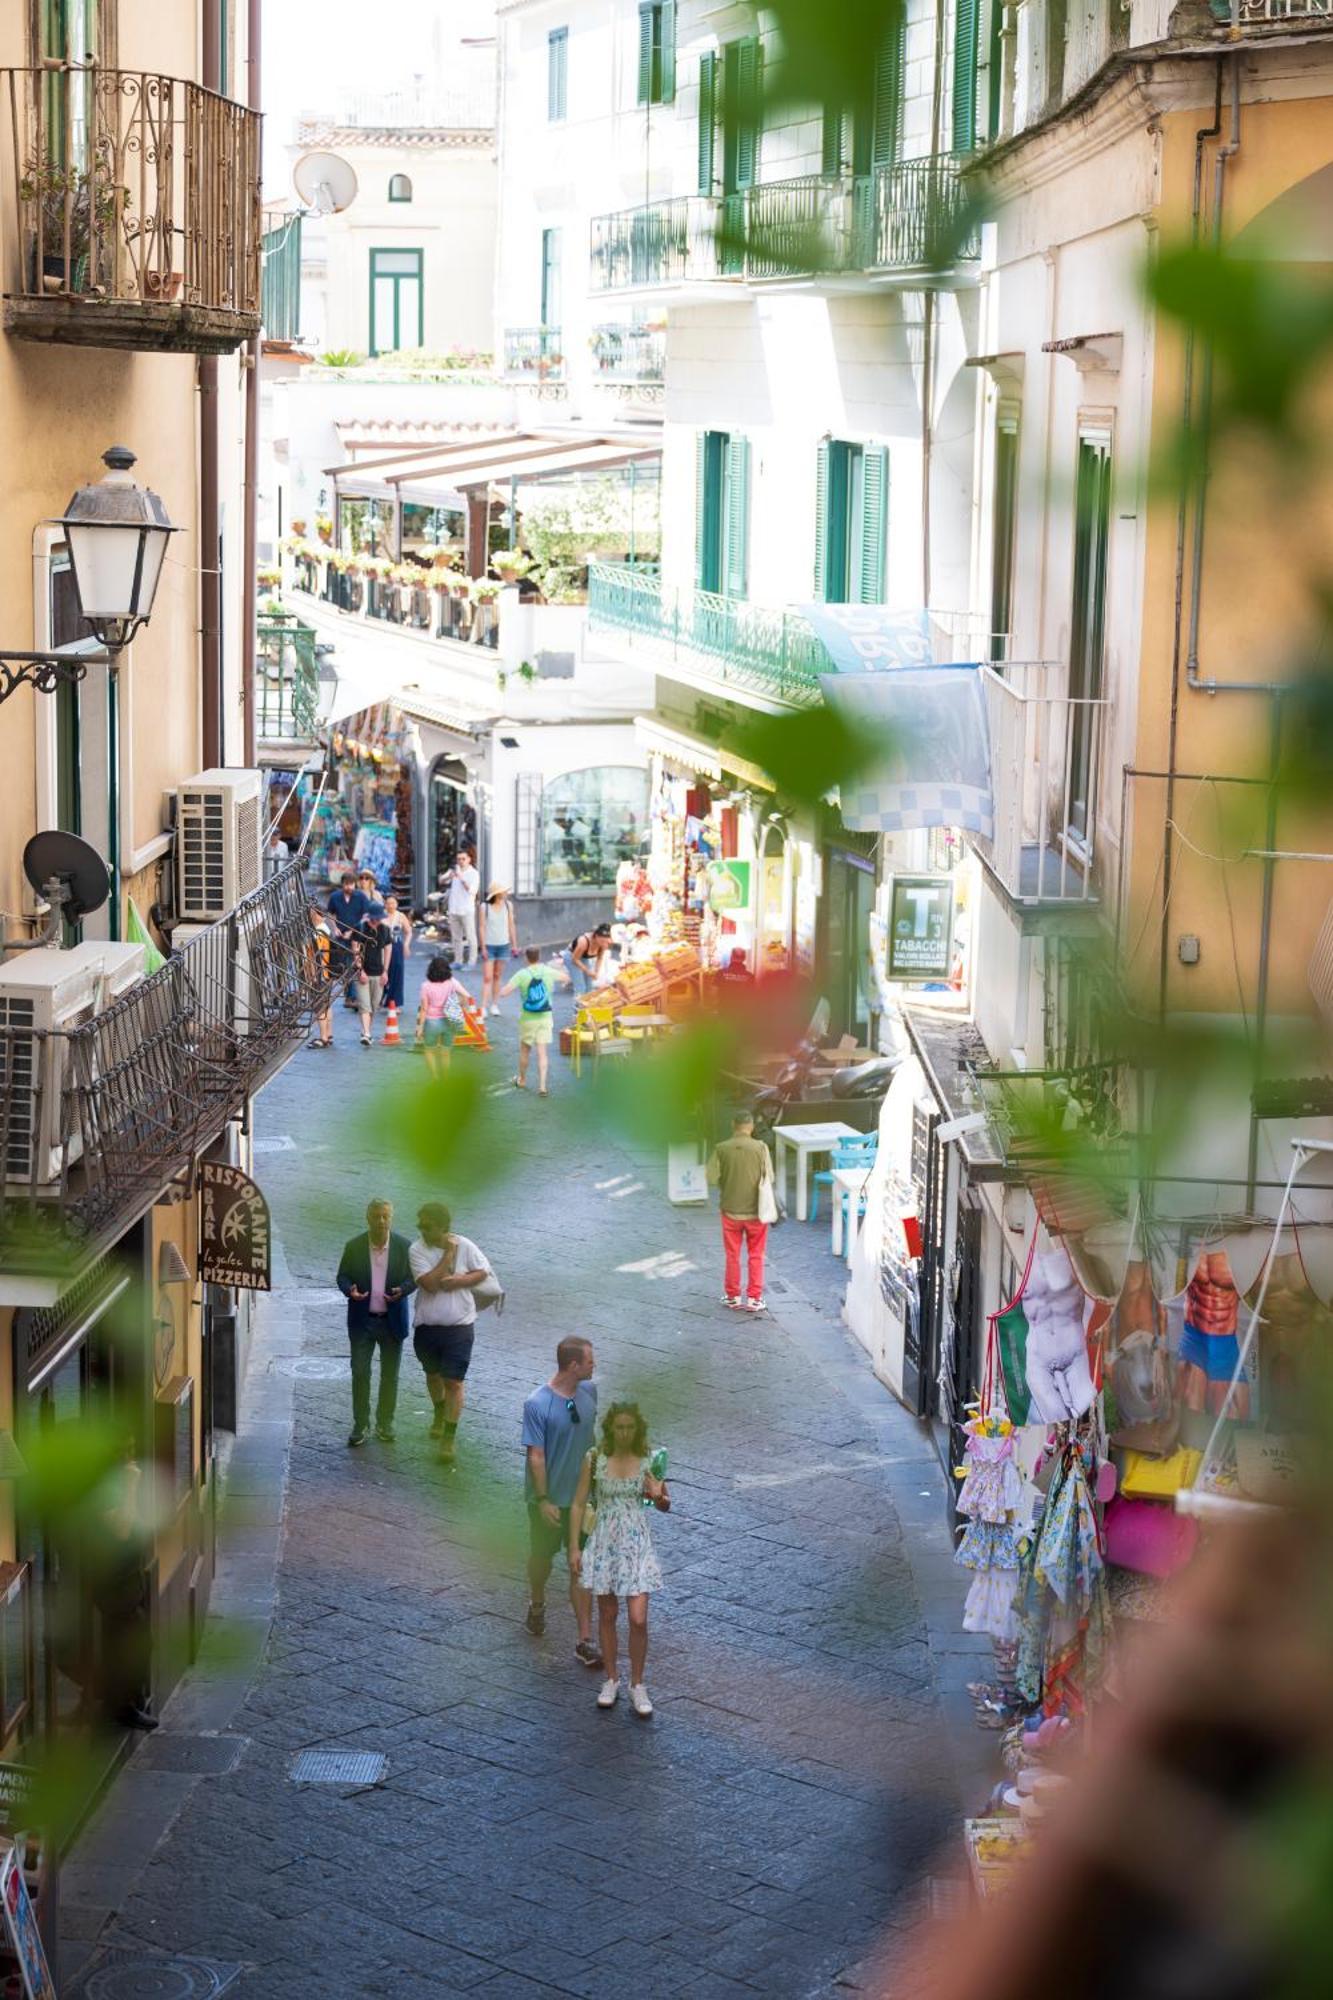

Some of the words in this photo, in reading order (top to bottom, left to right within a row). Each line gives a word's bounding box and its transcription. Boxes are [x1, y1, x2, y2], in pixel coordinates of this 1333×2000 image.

[906, 888, 939, 937] T
[894, 939, 947, 953] TABACCHI
[203, 1187, 216, 1241] BAR
[203, 1164, 268, 1271] RISTORANTE
[203, 1267, 268, 1290] PIZZERIA
